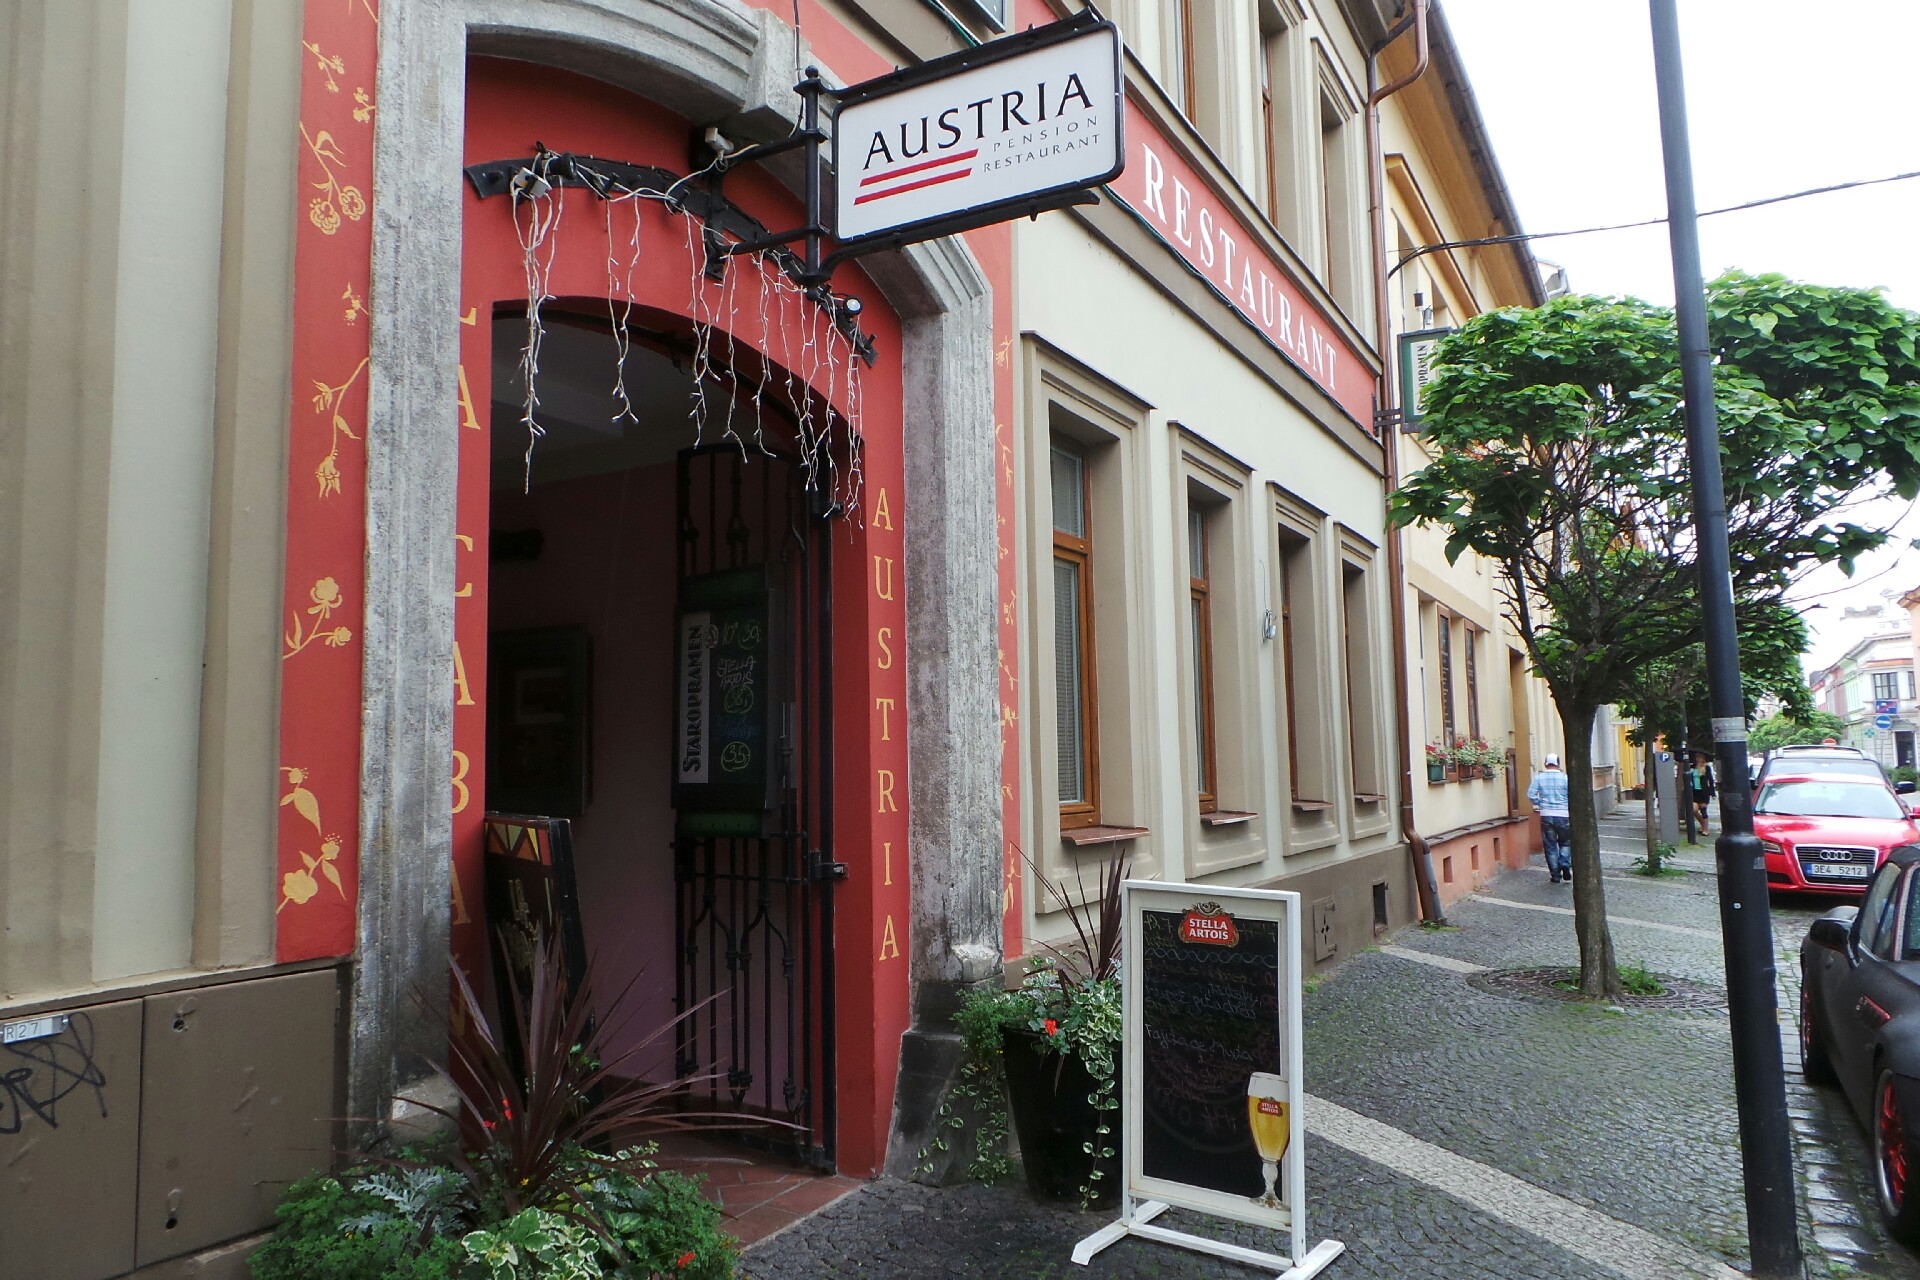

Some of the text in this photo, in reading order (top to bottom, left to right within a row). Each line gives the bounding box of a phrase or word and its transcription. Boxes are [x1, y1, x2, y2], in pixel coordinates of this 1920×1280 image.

[863, 73, 1093, 170] AUSTRIA
[993, 116, 1097, 152] PENSION
[983, 134, 1101, 172] RESTAURANT
[1141, 142, 1337, 390] RESTAURANT
[717, 655, 757, 677] STELLA
[683, 625, 703, 772] STAROPRAMEN
[872, 487, 900, 961] AUSTRIA
[1662, 753, 1669, 762] P
[1814, 865, 1862, 875] 3E4 5212
[1189, 918, 1228, 930] STELLA
[1189, 928, 1229, 940] ARTOIS
